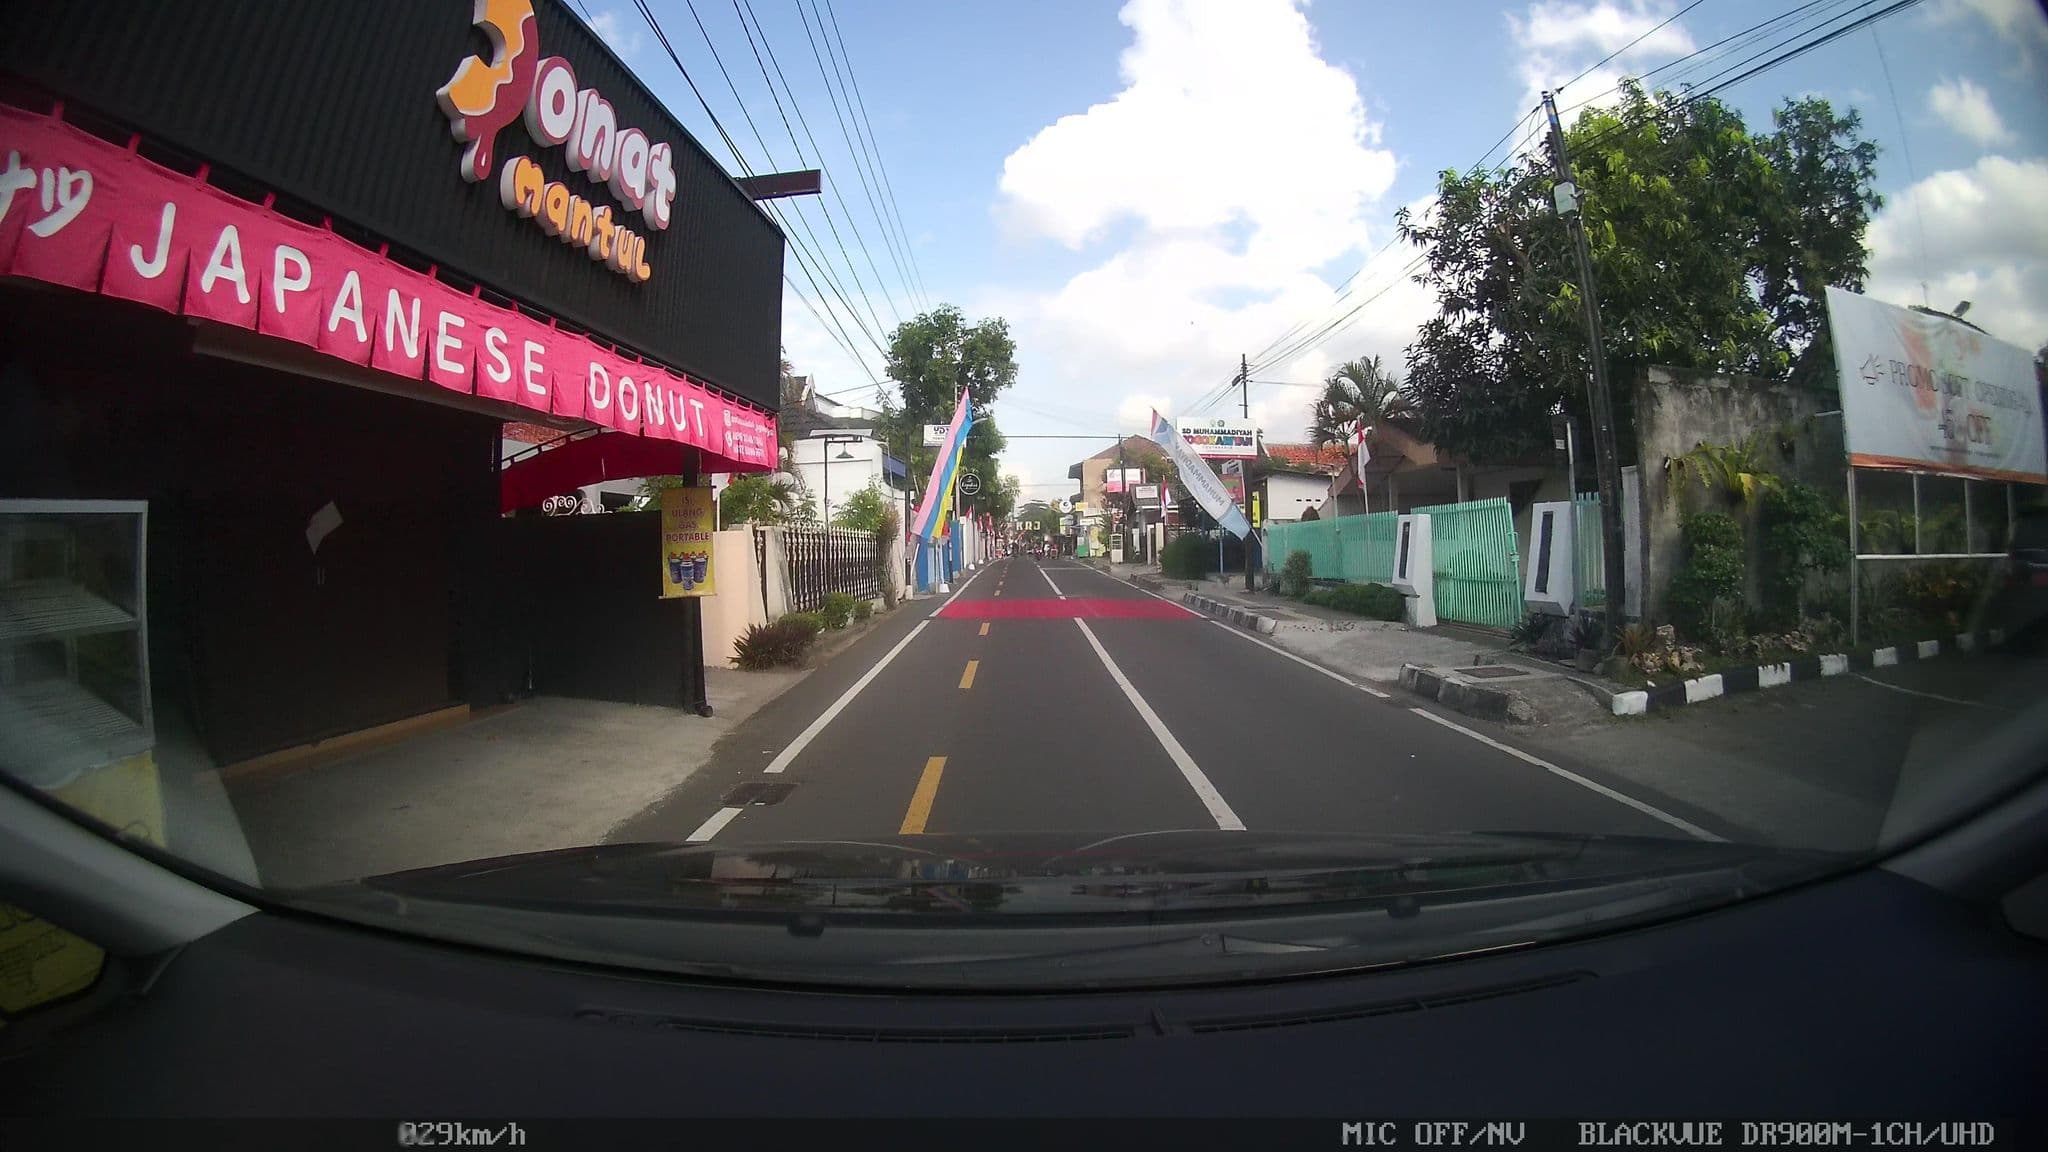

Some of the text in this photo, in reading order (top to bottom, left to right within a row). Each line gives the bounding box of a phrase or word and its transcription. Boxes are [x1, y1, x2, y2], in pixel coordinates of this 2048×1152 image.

[130, 202, 704, 437] JAPANESE DONUT
[665, 532, 710, 542] PORTABLE
